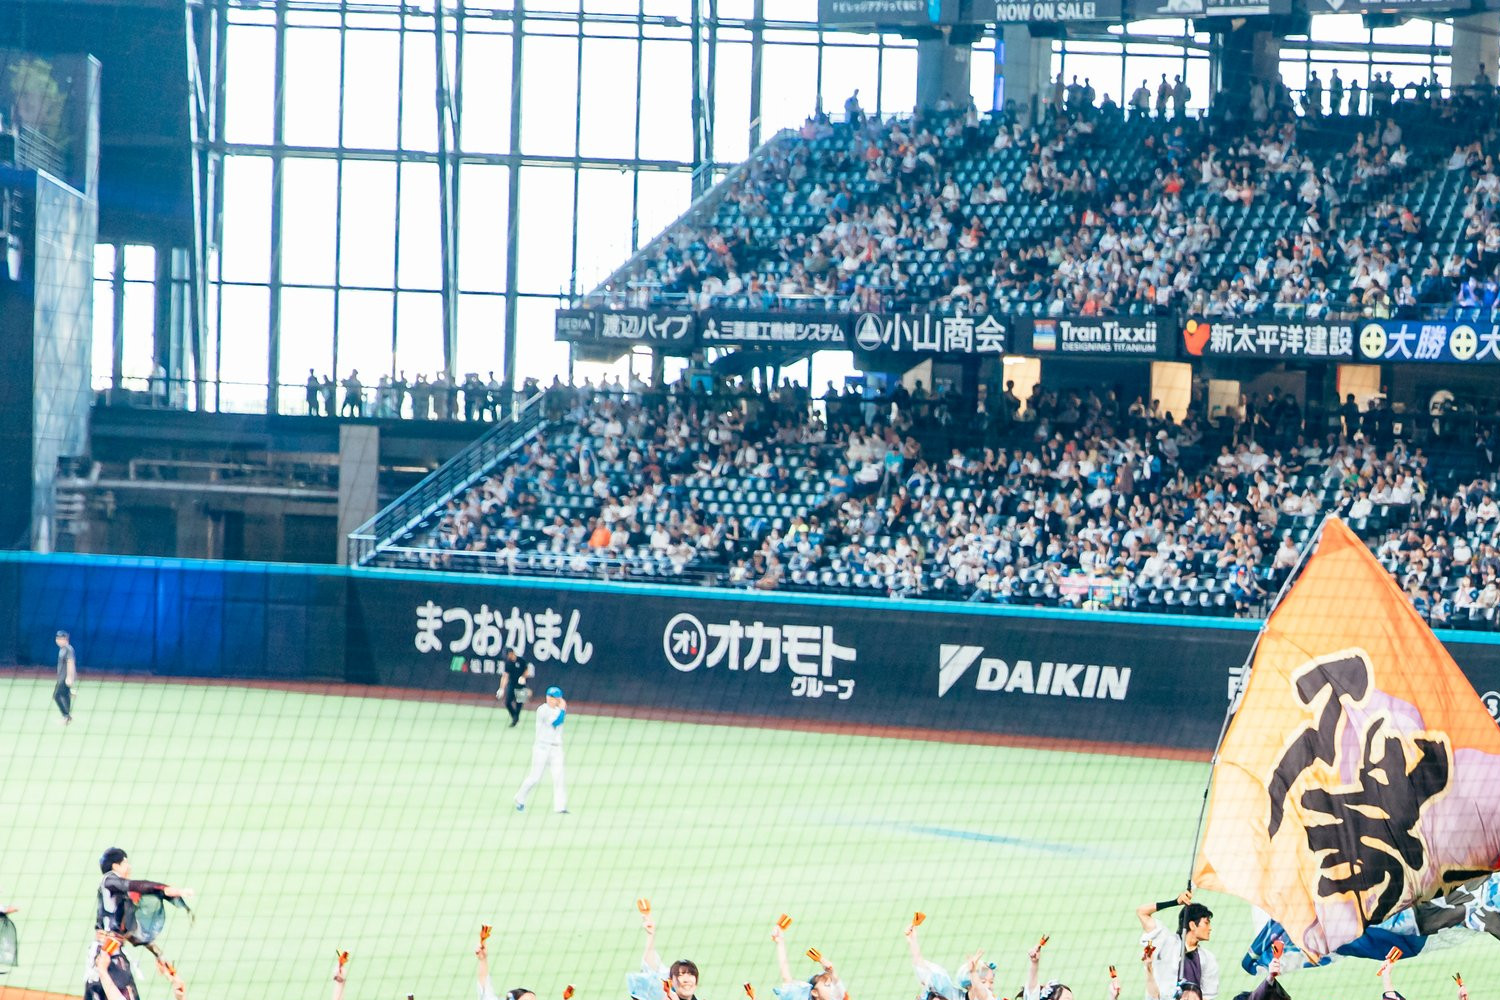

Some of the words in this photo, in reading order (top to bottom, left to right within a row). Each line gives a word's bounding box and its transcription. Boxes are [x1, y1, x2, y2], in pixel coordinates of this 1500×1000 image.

[996, 3, 1031, 21] NOW
[1032, 3, 1055, 20] ON
[1057, 1, 1096, 20] SALE!
[882, 311, 1006, 352] 小山商会
[1059, 320, 1157, 344] TranTixxii
[1061, 342, 1112, 352] DESIGNING
[1210, 323, 1353, 356] 新太平洋建設
[1383, 323, 1447, 360] 大勝
[414, 600, 594, 665] まつおかまん
[706, 619, 857, 677] オカモト
[790, 676, 856, 700] グループ
[975, 657, 1132, 700] DAIKIN
